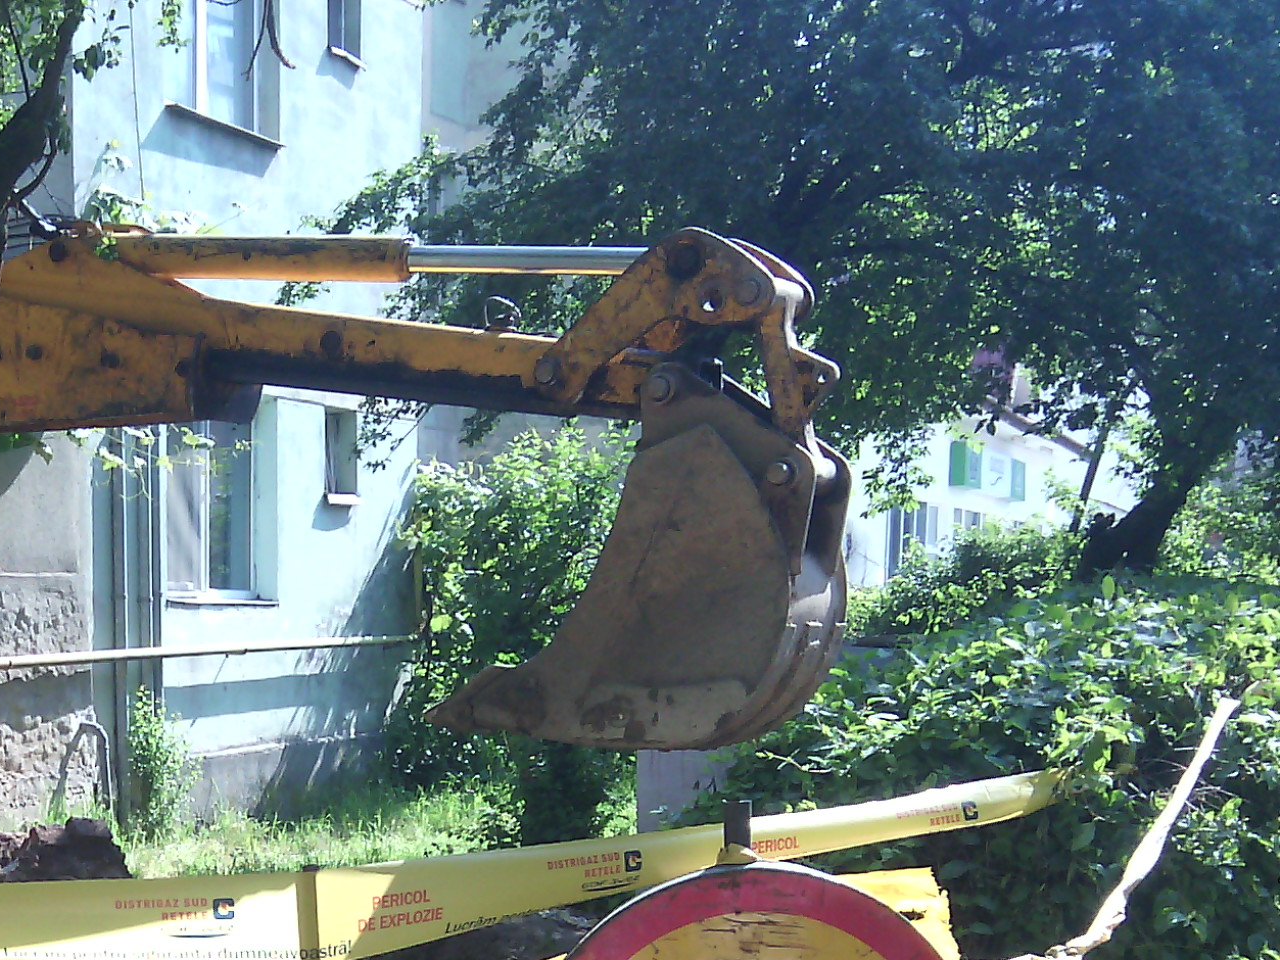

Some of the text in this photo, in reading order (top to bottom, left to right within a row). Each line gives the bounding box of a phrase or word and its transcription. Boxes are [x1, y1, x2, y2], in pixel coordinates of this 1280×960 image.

[751, 836, 800, 854] PERICOL
[546, 851, 620, 871] DISTRIGAZ SUD
[583, 864, 621, 878] RETELE
[115, 897, 209, 910] DISTRIGAZ SUD
[372, 889, 431, 910] PERICOL
[161, 910, 209, 922] RETELE
[357, 906, 444, 934] DE EXPLOZIE
